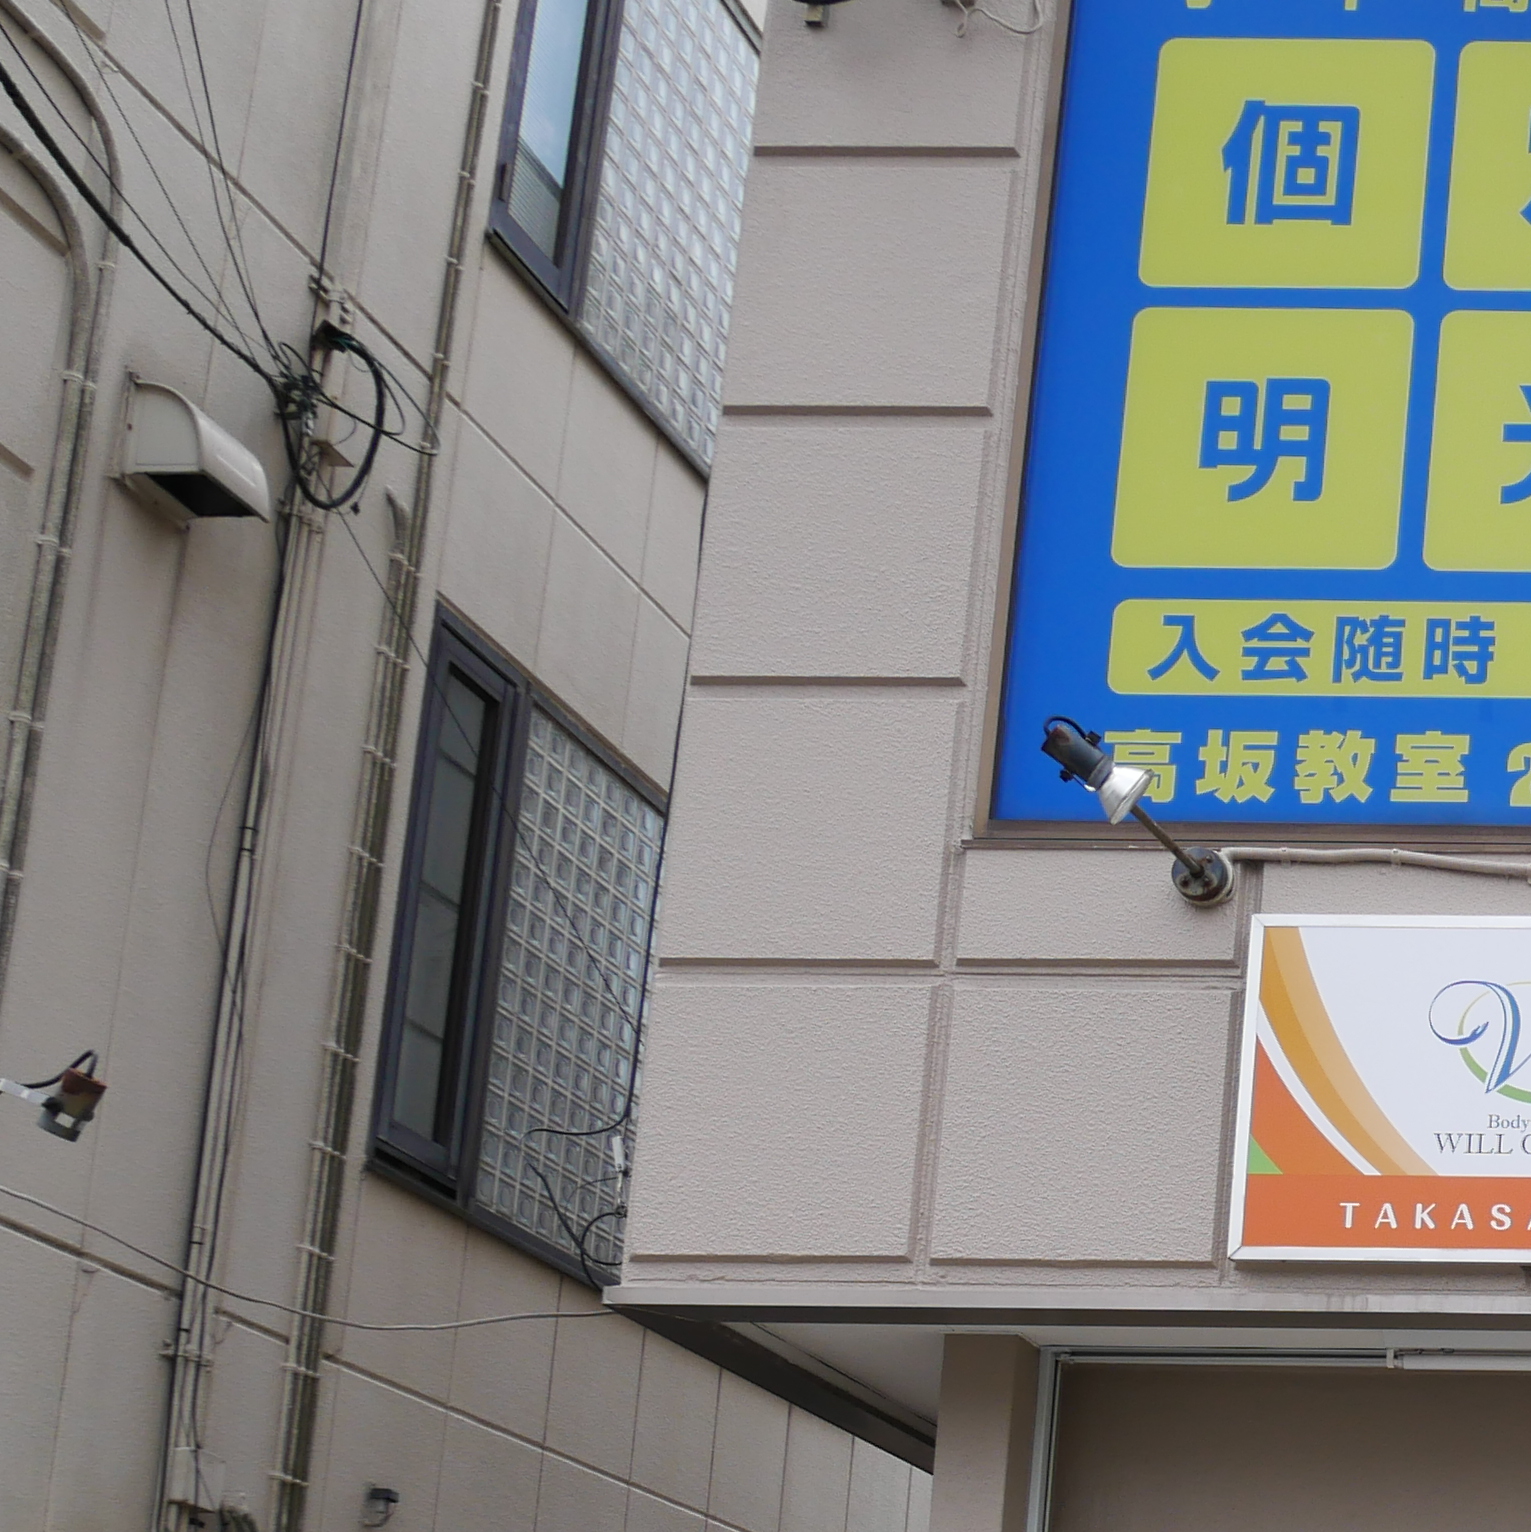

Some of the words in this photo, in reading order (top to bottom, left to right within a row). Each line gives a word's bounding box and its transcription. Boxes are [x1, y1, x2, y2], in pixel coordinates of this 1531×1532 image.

[1103, 729, 1471, 804] 高坂教室
[1486, 1114, 1531, 1132] Body
[1434, 1132, 1514, 1155] WILL
